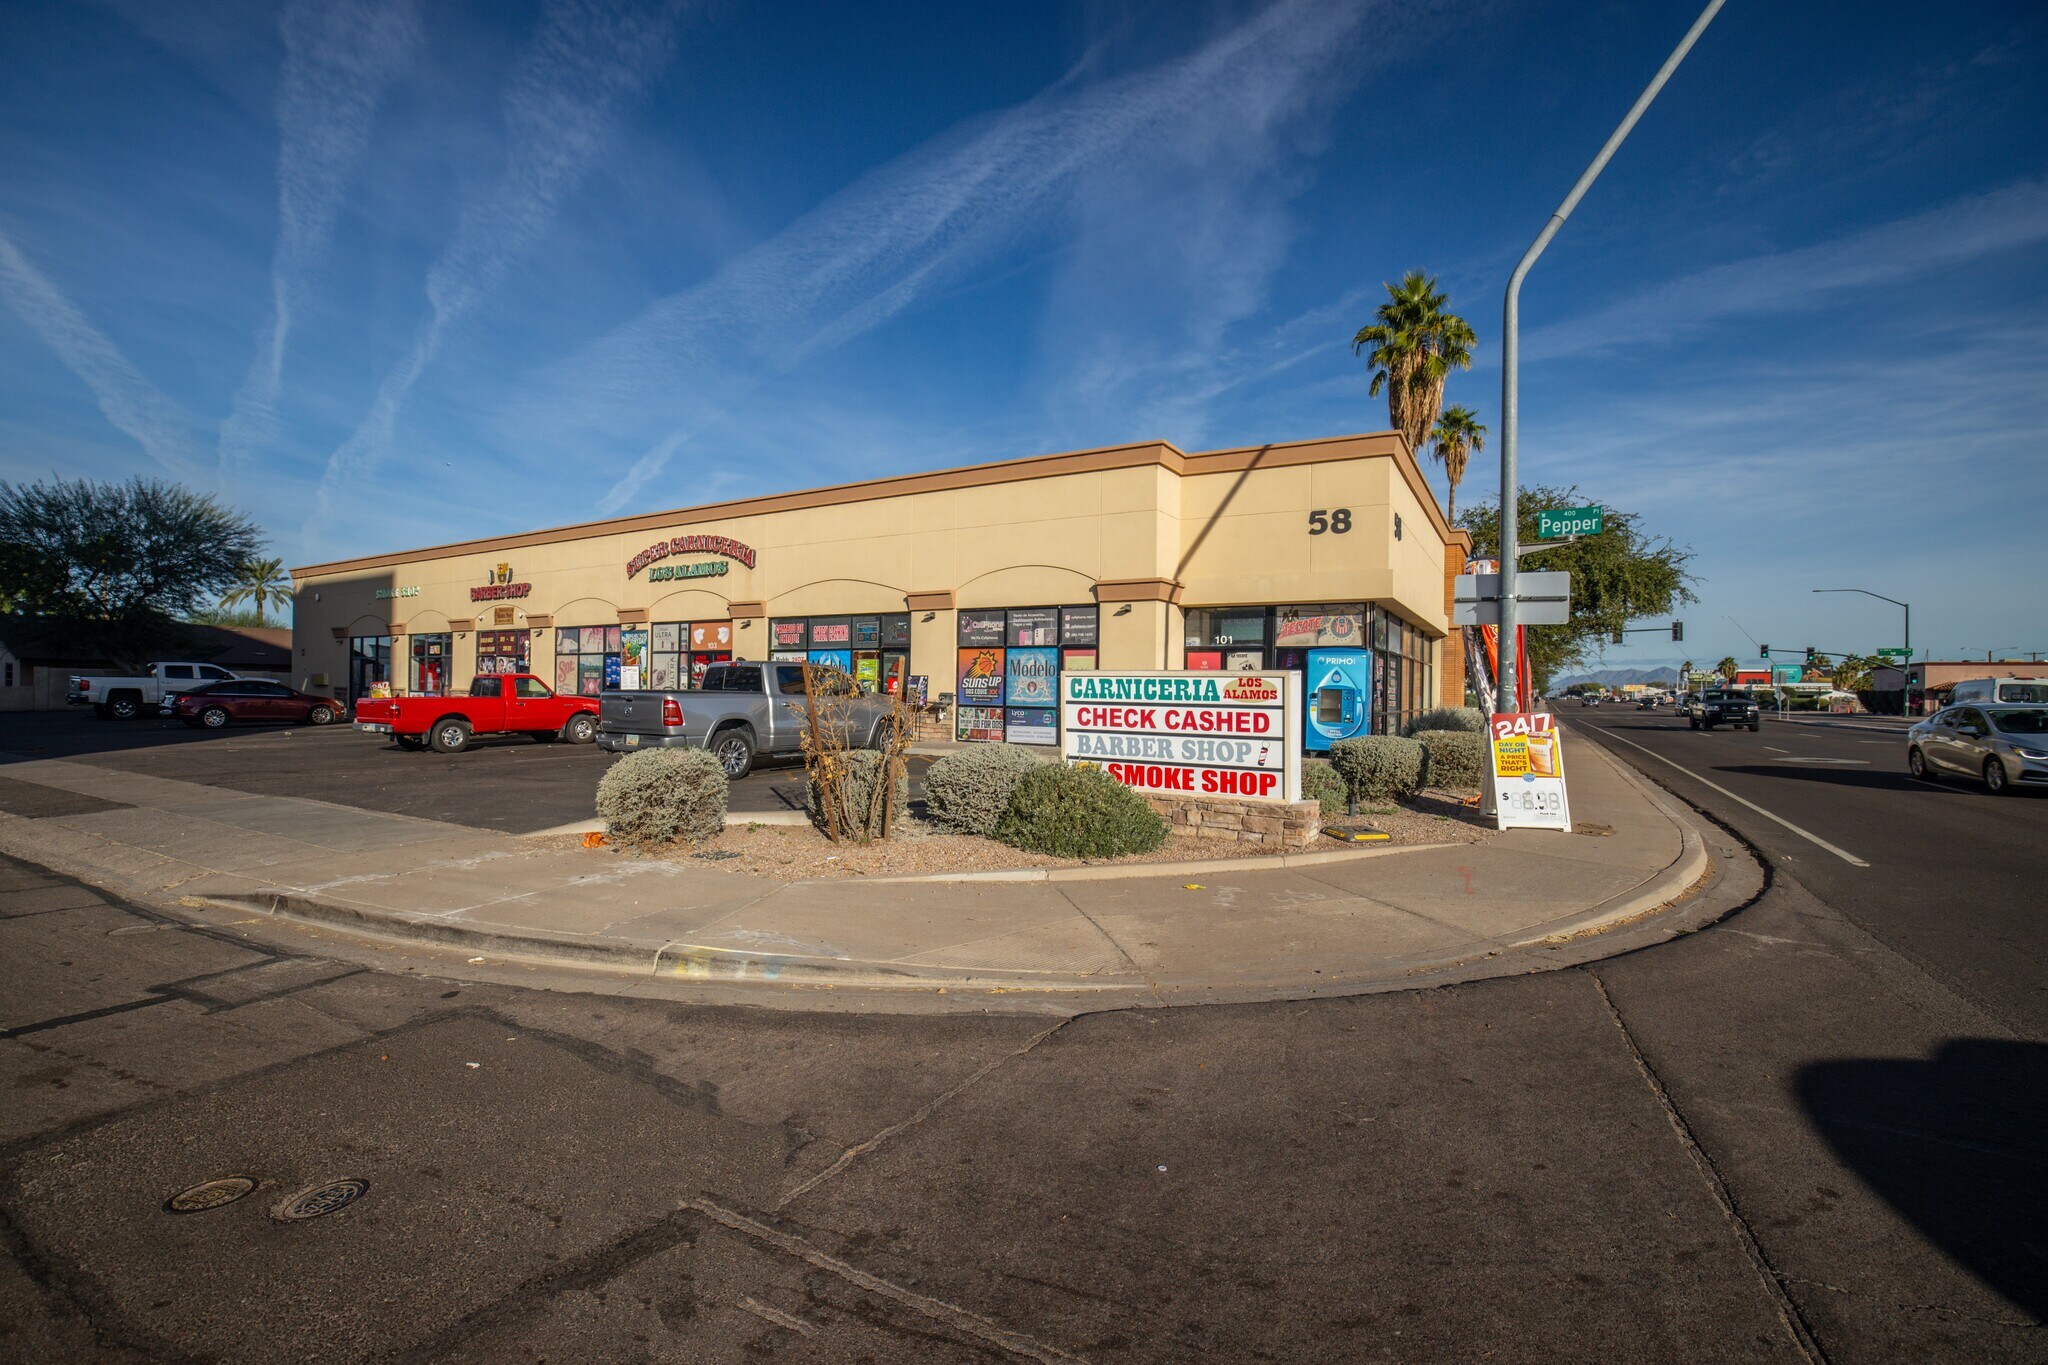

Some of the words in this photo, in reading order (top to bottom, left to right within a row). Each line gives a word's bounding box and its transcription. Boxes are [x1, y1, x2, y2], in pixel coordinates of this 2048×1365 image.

[1308, 509, 1352, 535] 58
[1541, 518, 1598, 535] Pepper
[627, 541, 668, 579] SUPER
[670, 535, 755, 568] CARNICERIA
[649, 566, 672, 581] LOS
[675, 561, 728, 579] ALAMOS
[401, 586, 419, 597] SHOP
[470, 585, 503, 601] BARBER
[505, 582, 529, 598] SHOP
[775, 623, 796, 634] CAMBIO
[797, 623, 804, 633] DE
[813, 626, 828, 642] CHECK
[829, 625, 848, 641] CASHING
[1283, 616, 1324, 635] TECATE
[779, 634, 799, 644] CHEQUE
[1215, 636, 1233, 644] 101
[1010, 659, 1056, 677] Modelo
[582, 679, 601, 694] XX
[962, 678, 988, 688] SUNS
[989, 676, 1002, 687] UP
[1070, 678, 1220, 701] CARNICERIA
[1238, 678, 1262, 687] LOS
[1223, 690, 1277, 700] ALAMOS
[973, 720, 980, 728] GO
[981, 720, 991, 728] FOR
[992, 720, 1002, 729] DOS
[1077, 707, 1156, 729] CHECK
[1165, 710, 1270, 733] CASHED
[1077, 735, 1174, 759] BARBER
[1181, 740, 1252, 763] SHOP
[1108, 763, 1194, 790] SMOKE
[1202, 770, 1277, 796] SHOP
